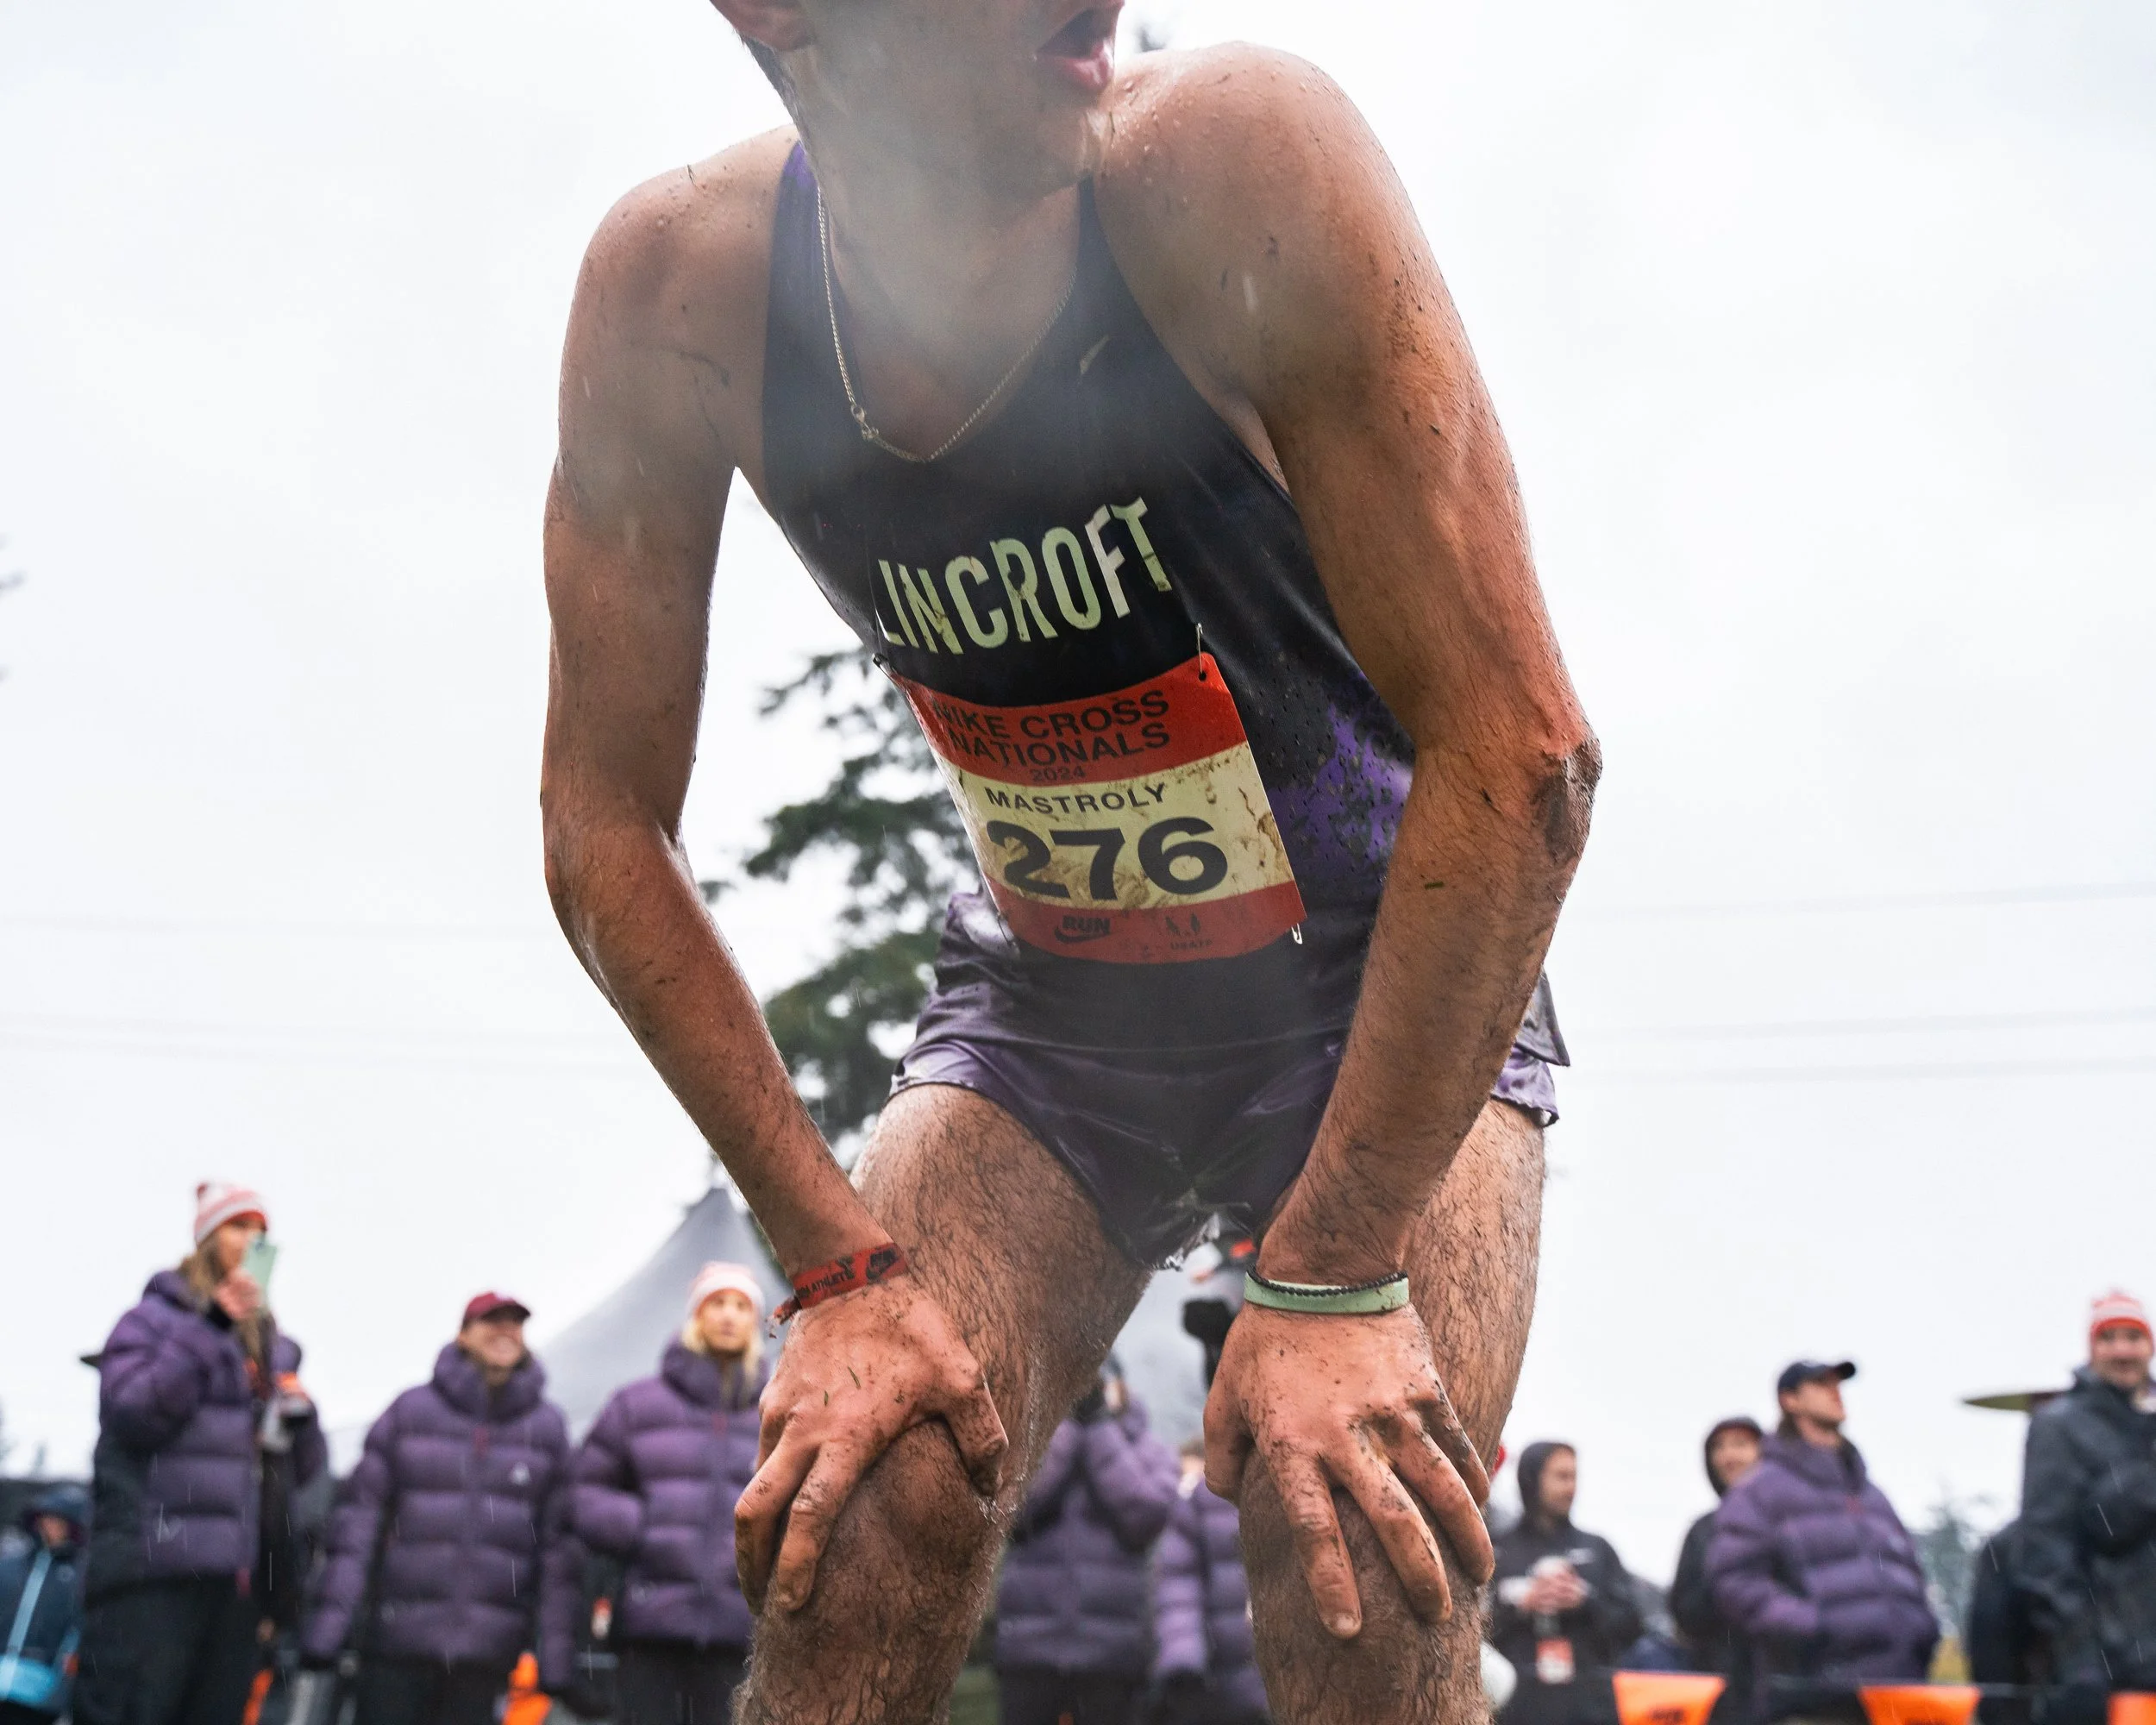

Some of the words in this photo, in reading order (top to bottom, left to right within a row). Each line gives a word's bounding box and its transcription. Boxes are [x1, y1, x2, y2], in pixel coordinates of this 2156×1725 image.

[932, 698, 1011, 738] NIKE
[1020, 690, 1169, 739] CROSS
[949, 722, 1170, 768] NATIONALS
[1030, 757, 1087, 782] 2024
[985, 782, 1166, 815] MASTROLY
[987, 816, 1228, 901] 276
[1062, 915, 1111, 936] RUN
